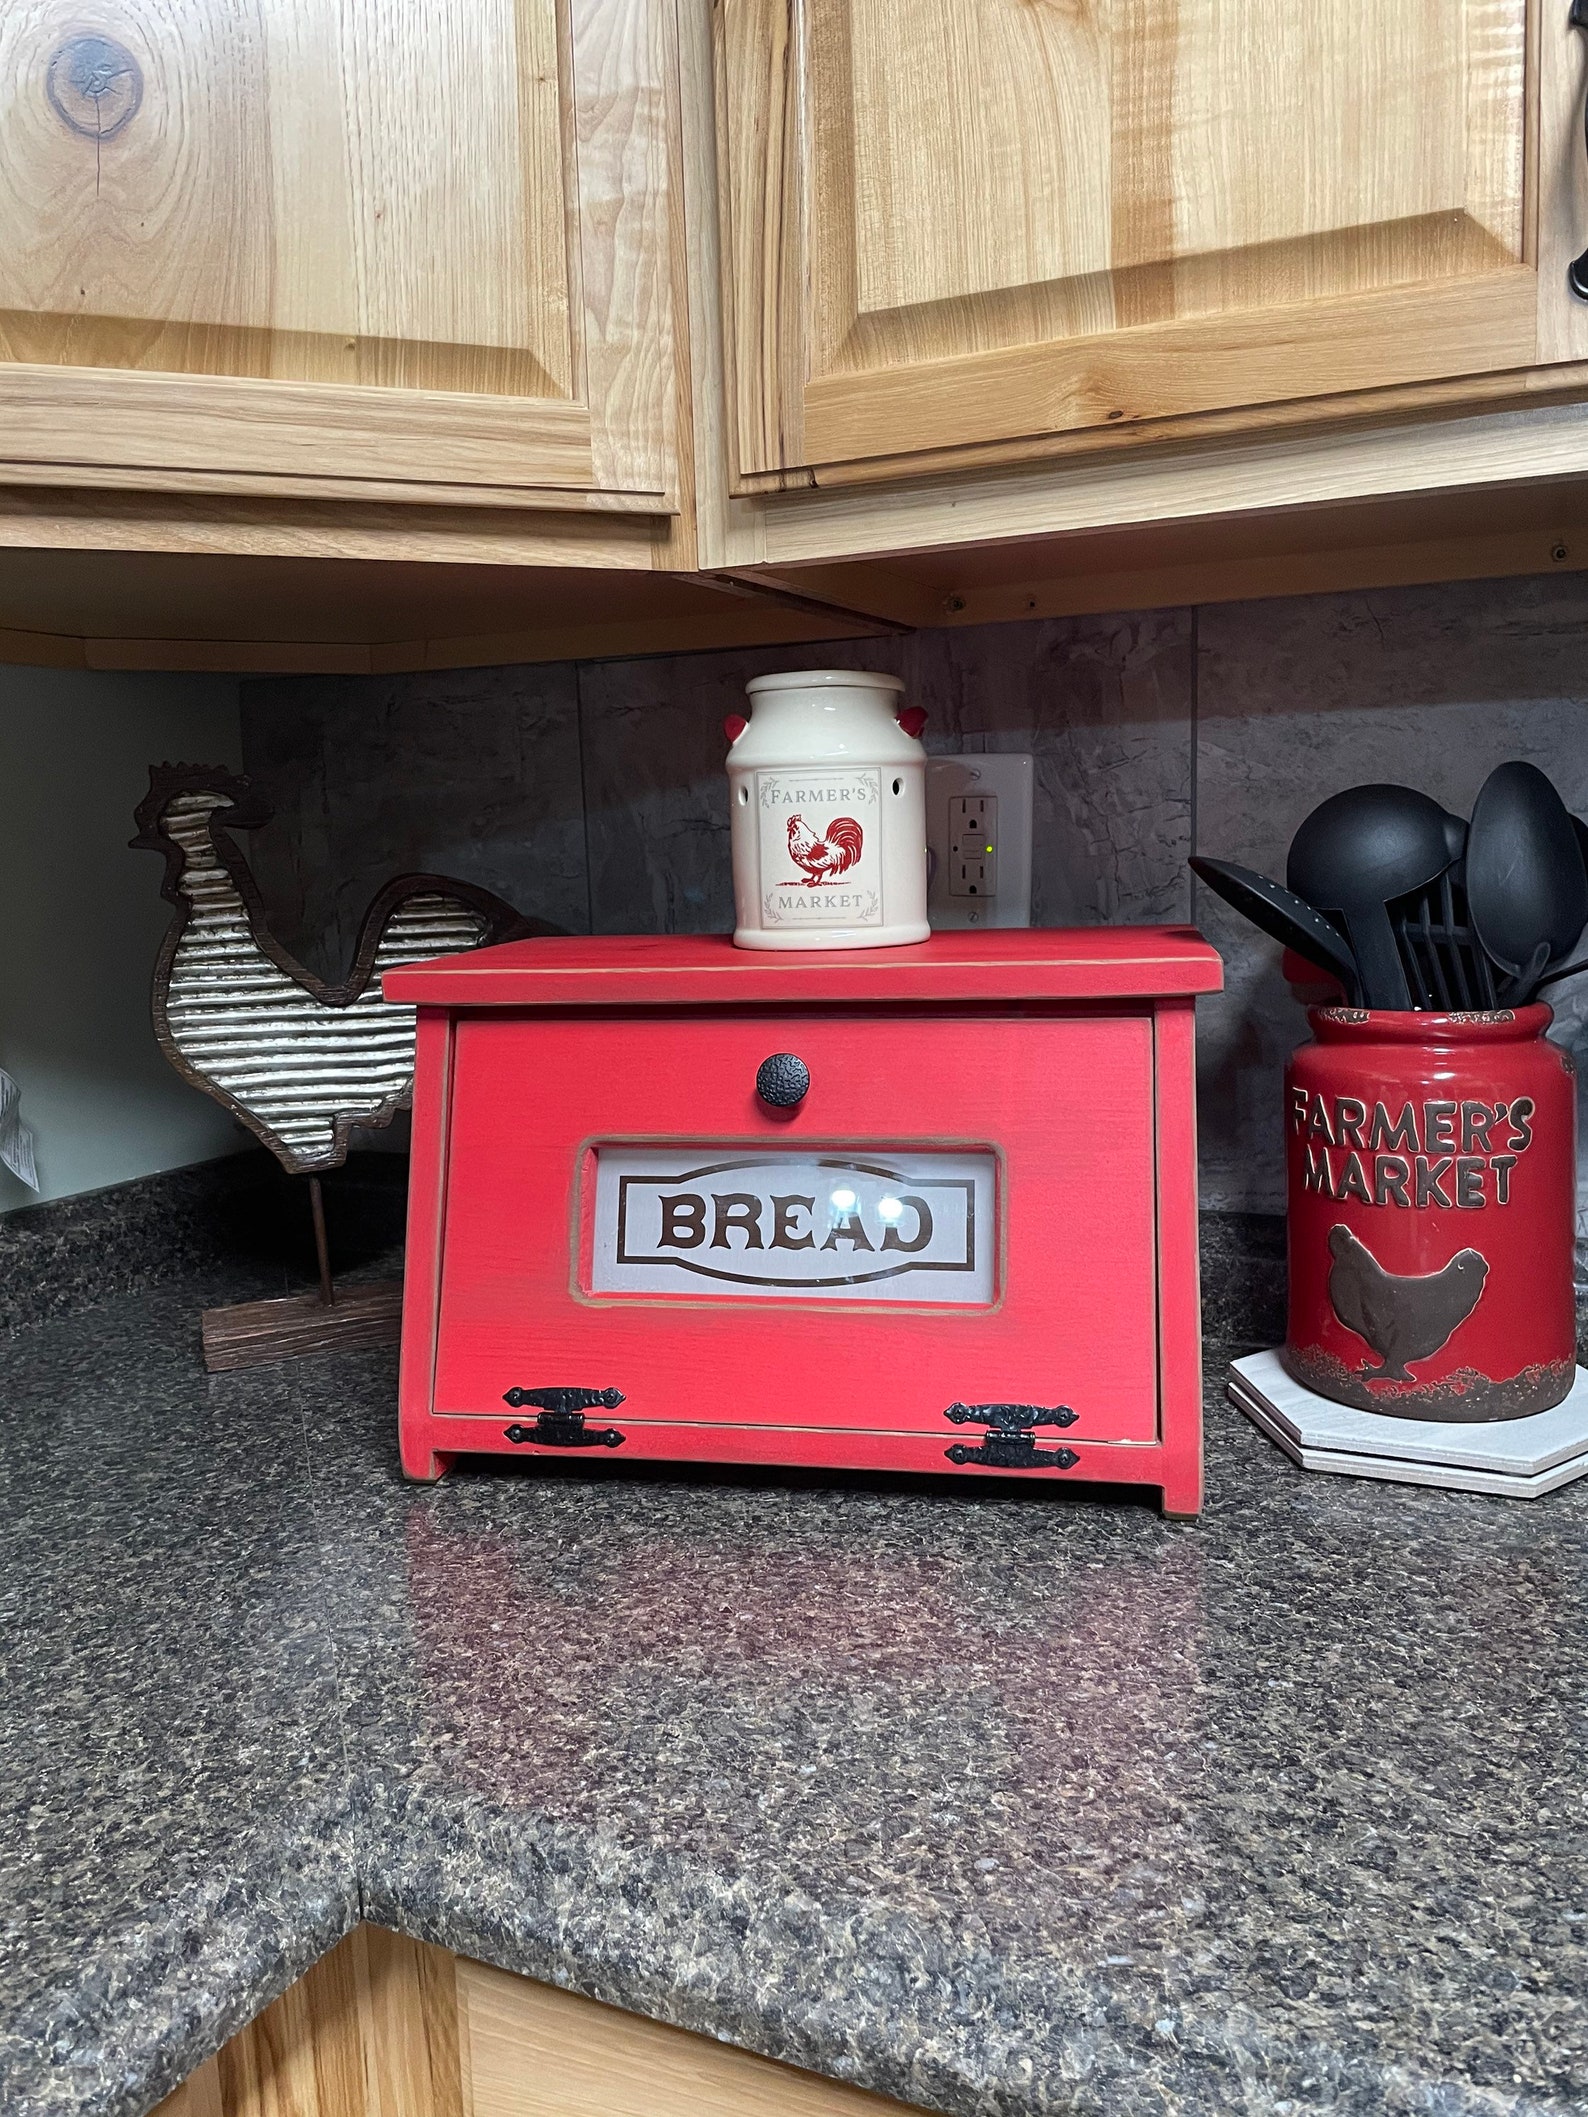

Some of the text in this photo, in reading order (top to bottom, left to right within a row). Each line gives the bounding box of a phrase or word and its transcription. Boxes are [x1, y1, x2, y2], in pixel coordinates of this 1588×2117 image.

[771, 788, 866, 803] FARMER'S
[778, 895, 863, 908] MARKET
[1292, 1086, 1535, 1153] FARMER'S
[1305, 1144, 1518, 1209] MARKET
[656, 1193, 934, 1253] BREAD
